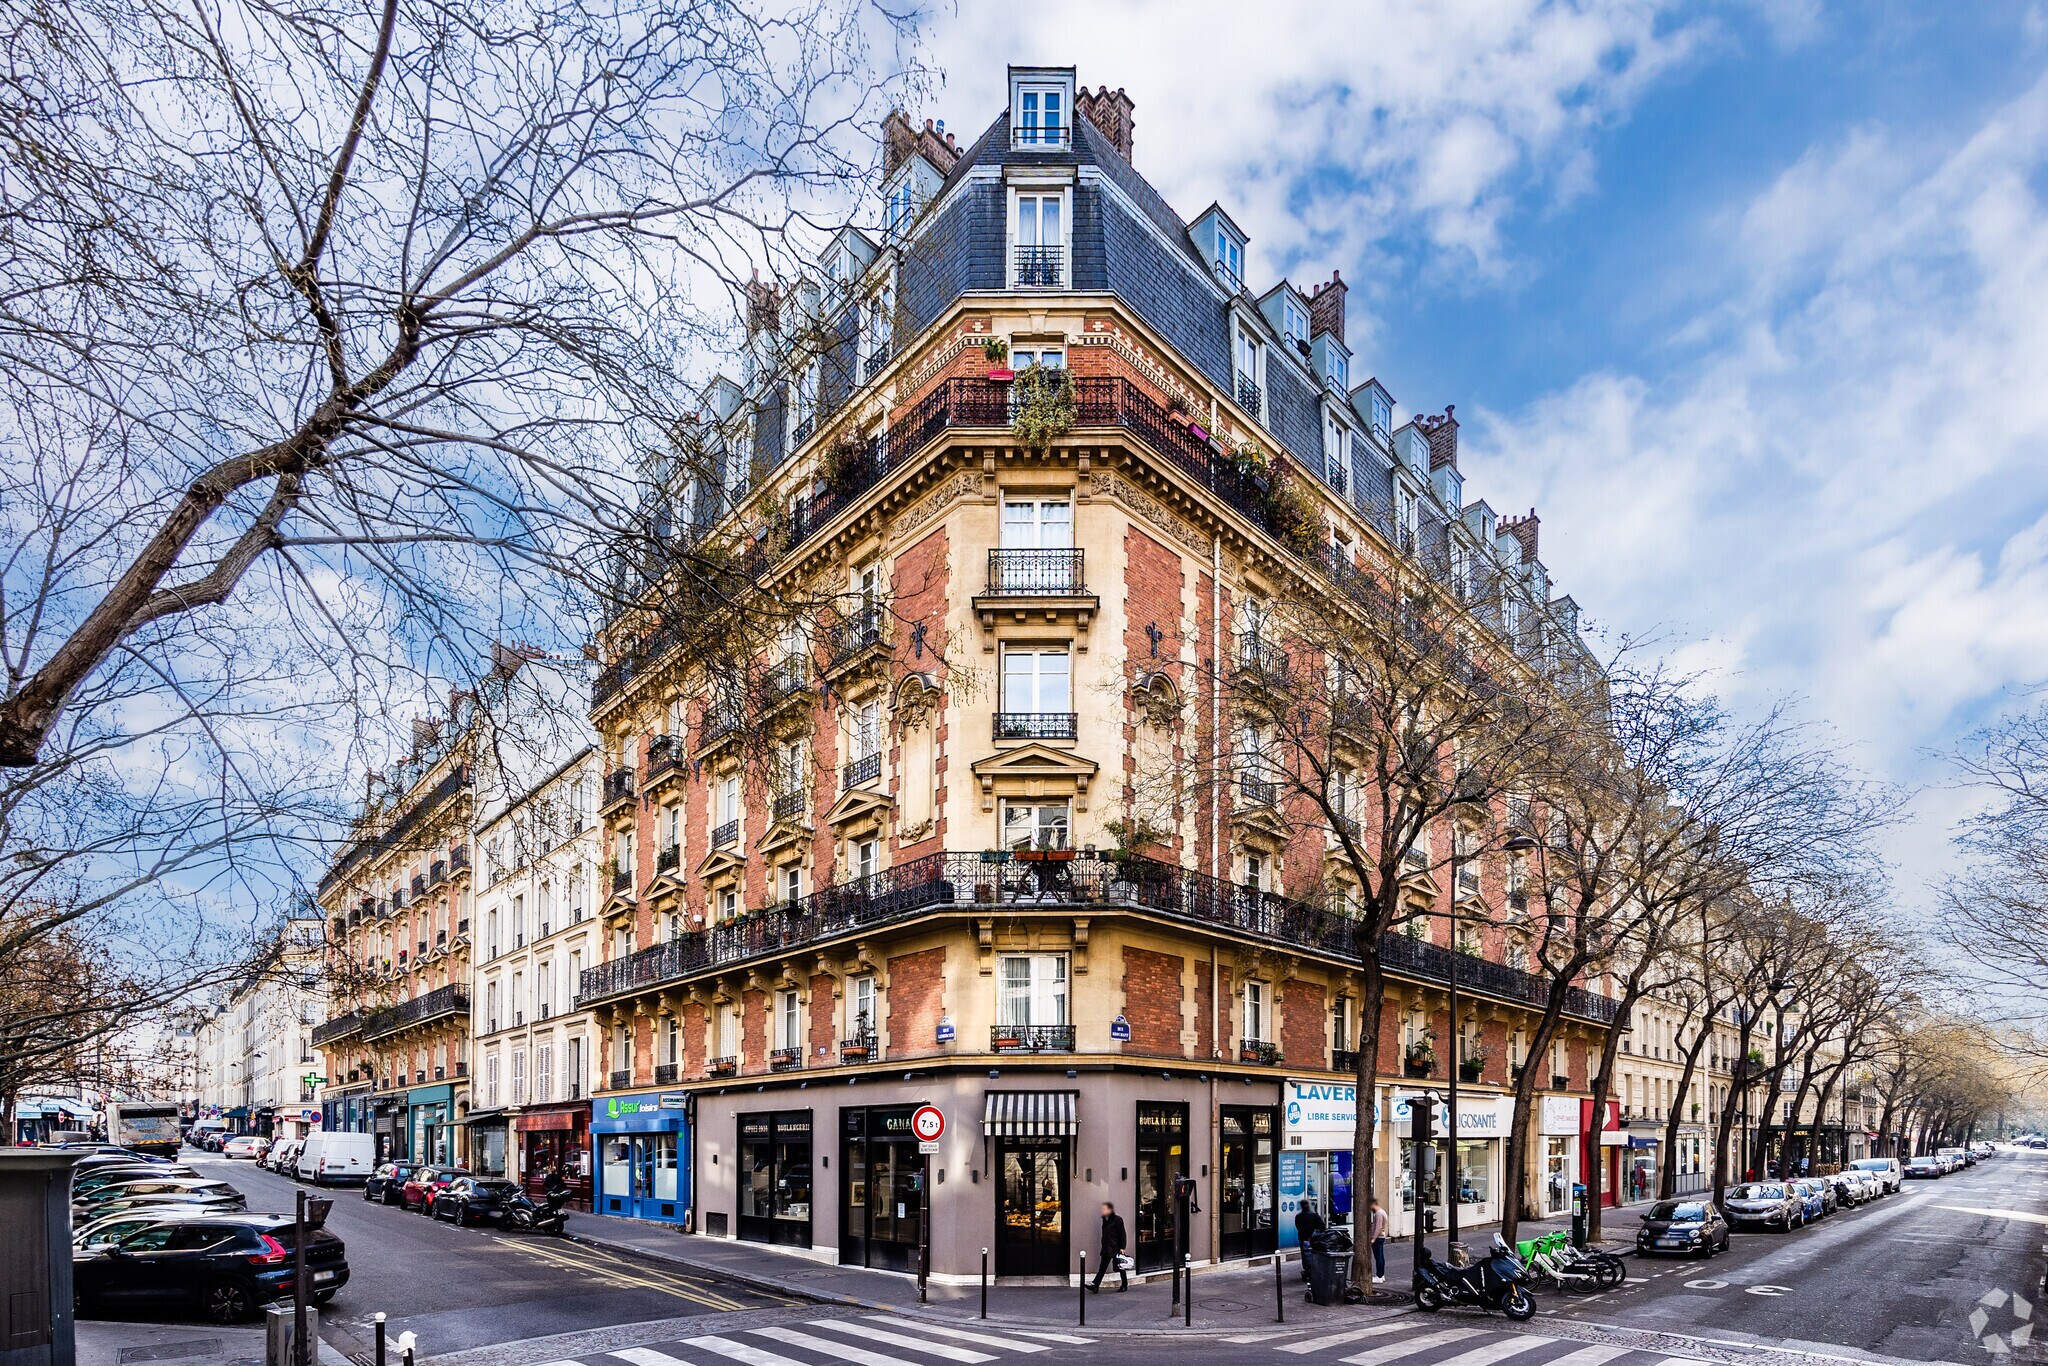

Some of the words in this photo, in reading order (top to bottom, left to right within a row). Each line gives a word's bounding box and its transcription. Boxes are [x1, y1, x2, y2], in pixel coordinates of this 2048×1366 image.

[1296, 1084, 1356, 1101] LAVER
[1307, 1112, 1330, 1121] LIBRE
[1331, 1112, 1357, 1121] SERVIC
[1457, 1112, 1497, 1129] IGOSANTÉ
[886, 1118, 912, 1131] GANA
